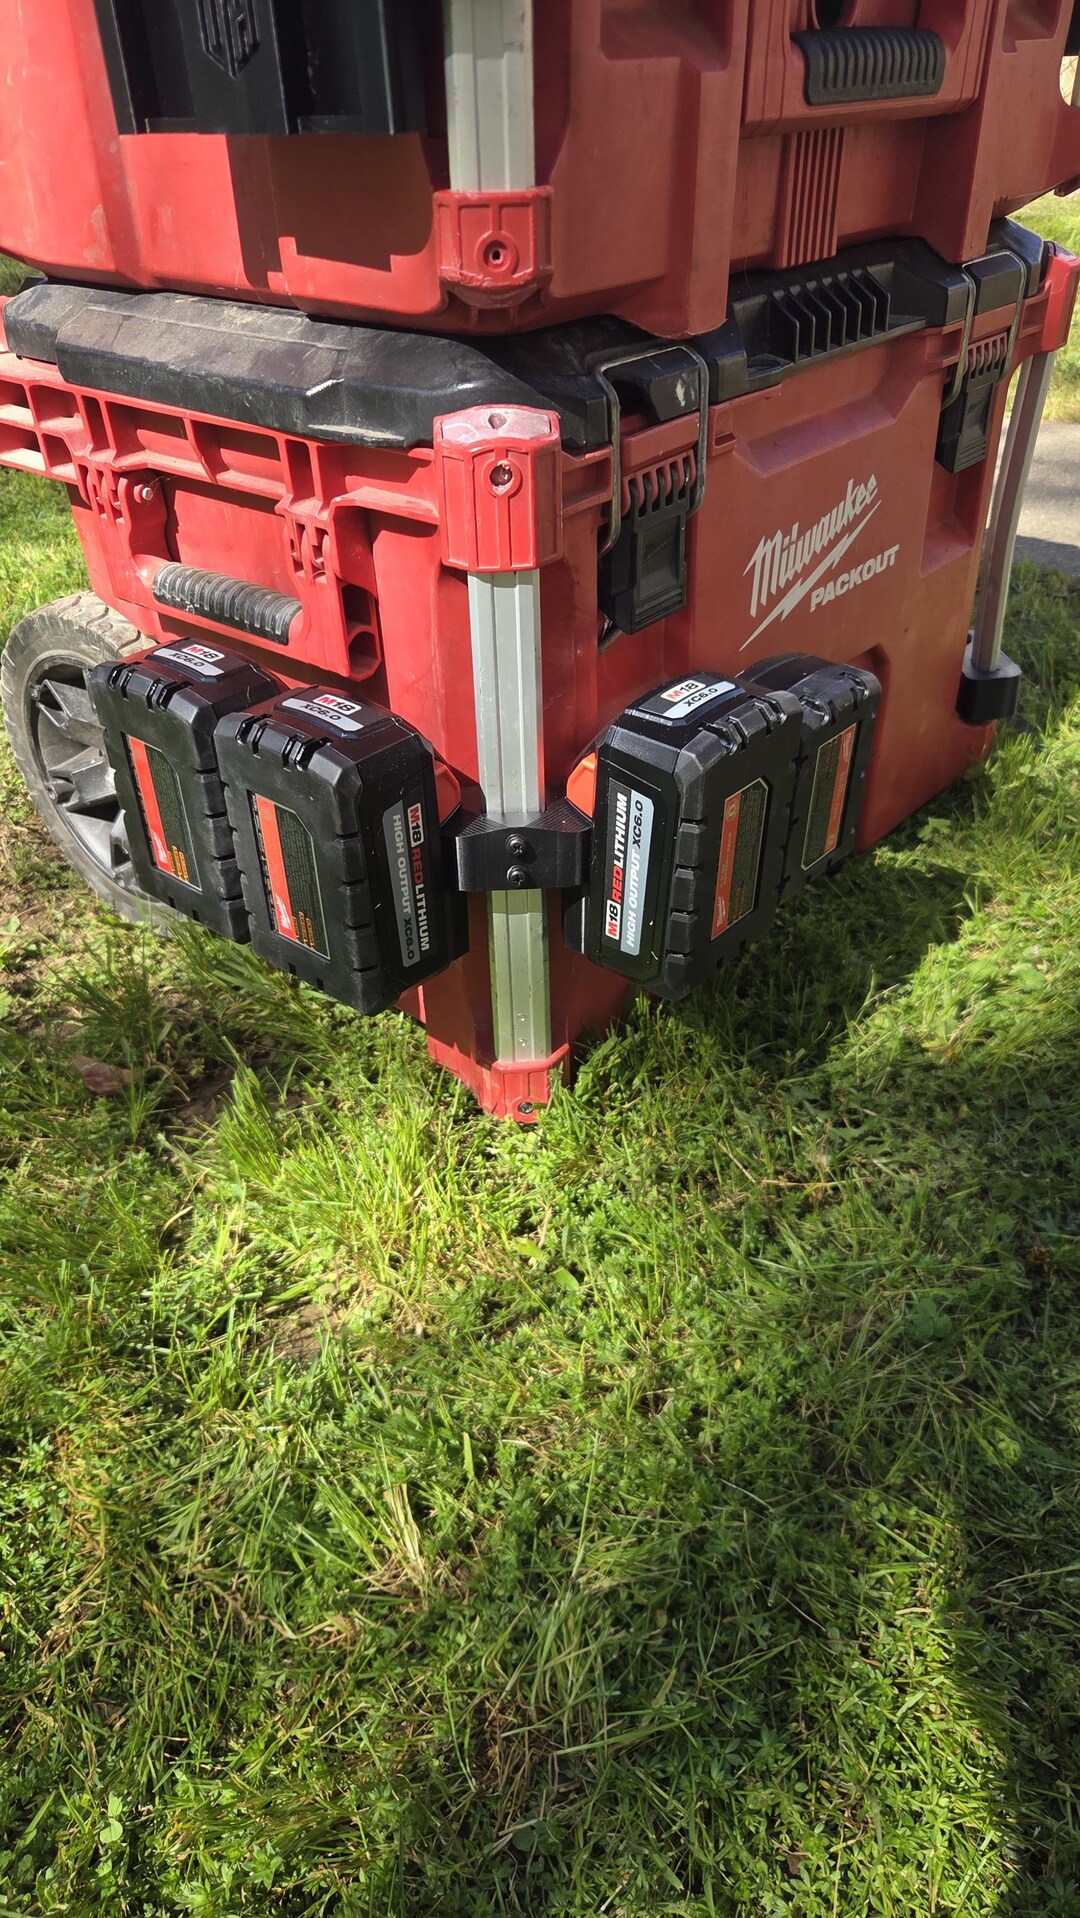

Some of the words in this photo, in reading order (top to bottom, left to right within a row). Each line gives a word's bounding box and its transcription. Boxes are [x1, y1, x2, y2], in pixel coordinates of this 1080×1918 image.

[743, 474, 878, 618] Milwaukee
[810, 544, 900, 613] PACKOUT
[187, 646, 220, 660] M18
[318, 696, 356, 712] M18
[666, 683, 699, 700] M18
[683, 688, 718, 707] XC6.0
[301, 704, 342, 721] XC6.0
[393, 815, 405, 853] HIGH
[409, 805, 422, 844] M18
[632, 799, 644, 849] XC6.0
[611, 792, 628, 904] REDLITHIUM
[397, 857, 412, 914] OUTPUT
[629, 849, 641, 910] OUTPUT
[412, 848, 430, 951] REDLITHIUM
[404, 917, 415, 961] XC6.0
[607, 903, 619, 937] M18
[626, 911, 637, 948] HIGH
